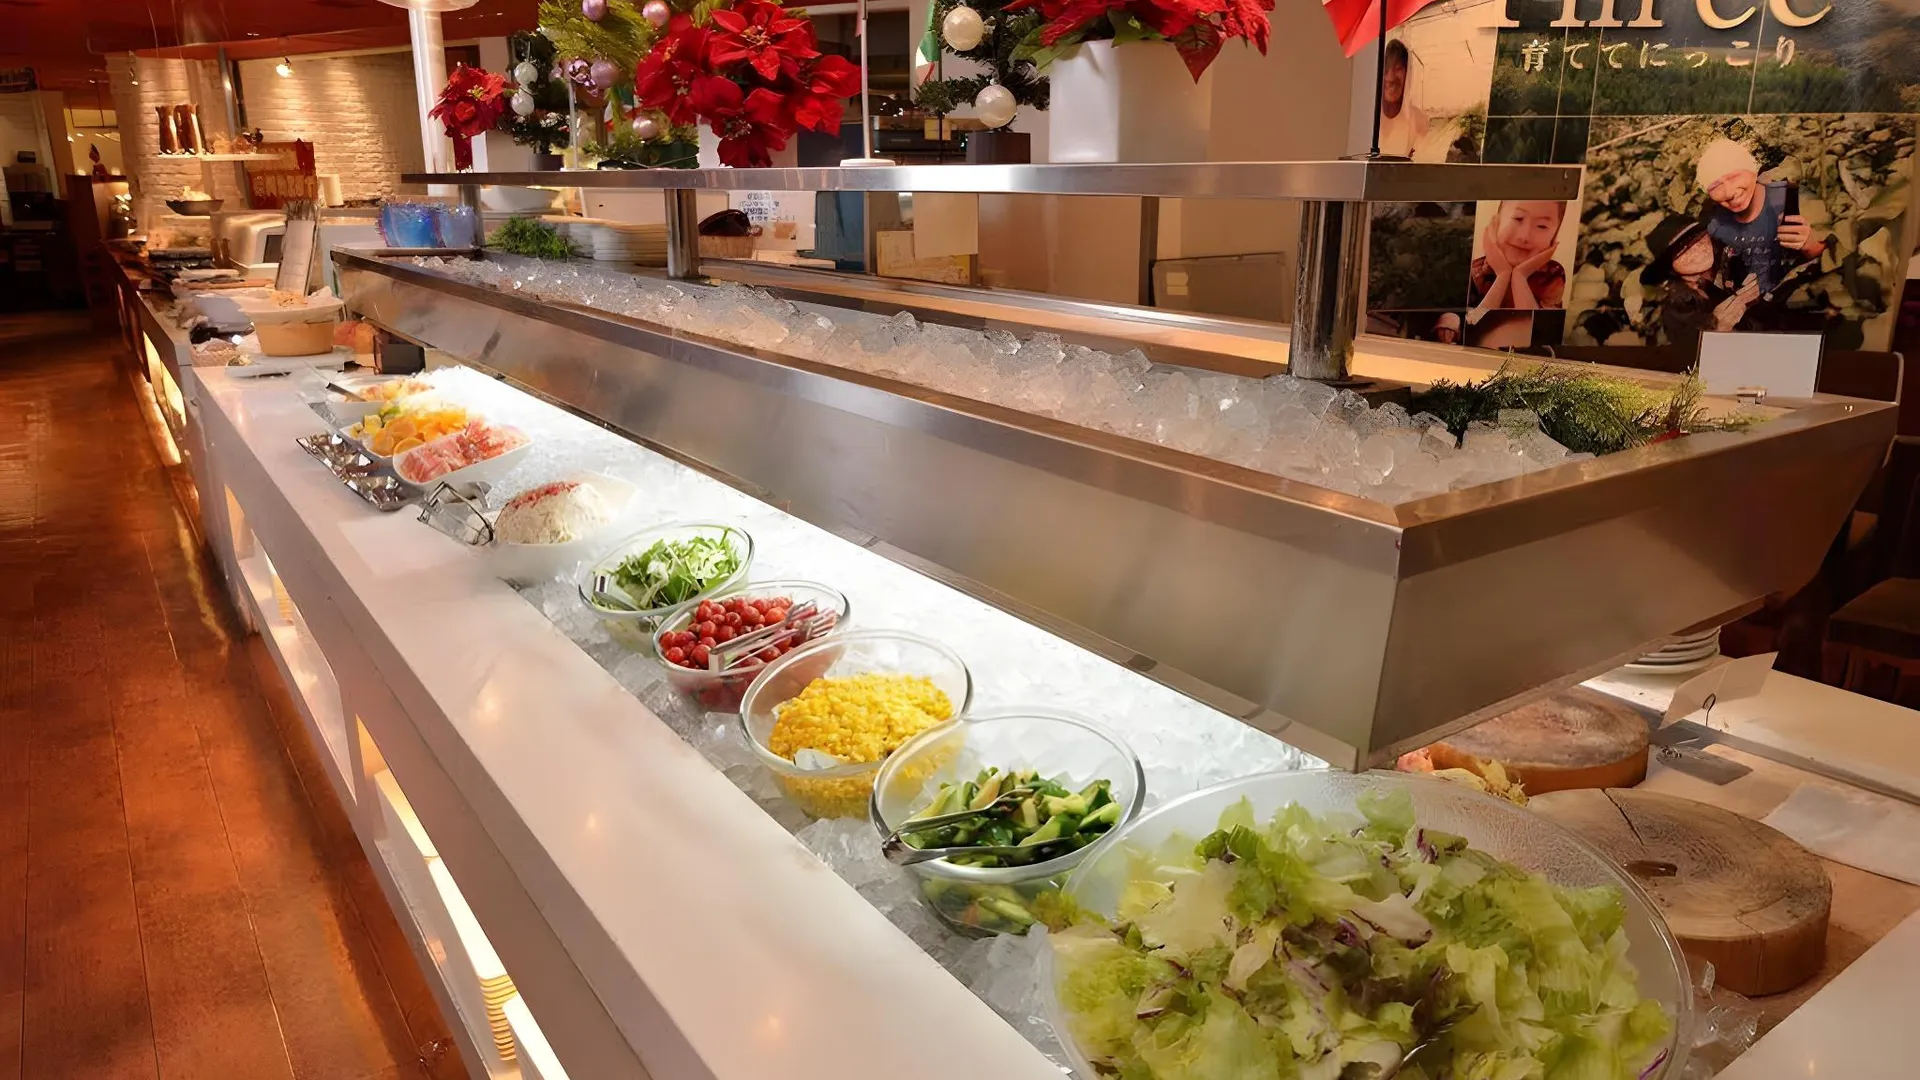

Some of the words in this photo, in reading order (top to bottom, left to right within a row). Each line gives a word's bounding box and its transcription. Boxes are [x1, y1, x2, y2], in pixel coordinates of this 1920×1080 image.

[1521, 35, 1796, 72] 育ててにっこり
